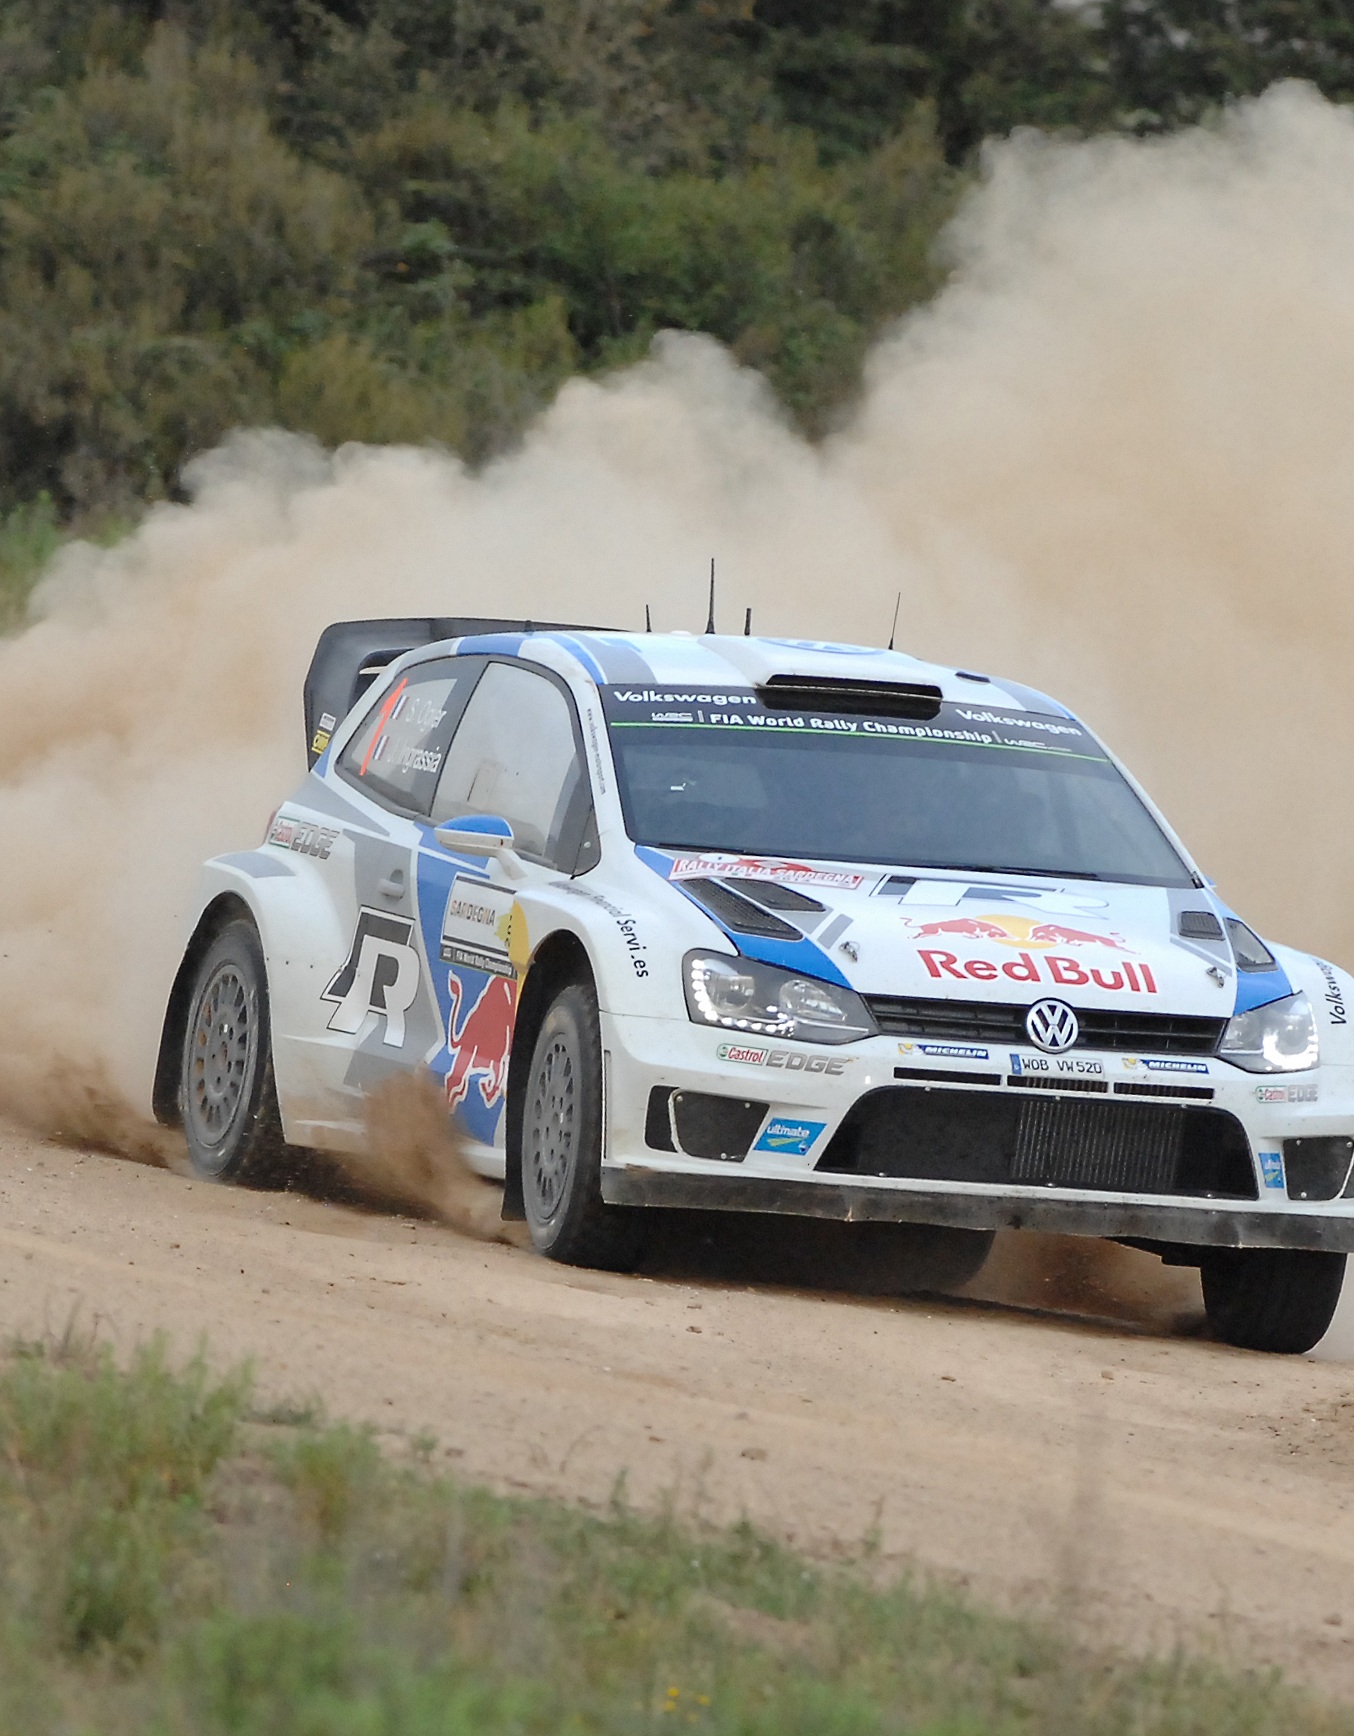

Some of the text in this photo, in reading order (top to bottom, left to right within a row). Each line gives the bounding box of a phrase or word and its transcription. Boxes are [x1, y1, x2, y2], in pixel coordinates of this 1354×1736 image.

[613, 690, 757, 706] Volkswagen
[710, 713, 743, 725] FIA
[747, 714, 804, 727] World
[810, 717, 858, 732] Rally
[862, 721, 992, 745] Championship
[955, 708, 1082, 736] Volkswagen
[677, 858, 724, 873] RALLY
[725, 864, 772, 877] ITALIA
[773, 868, 855, 884] SARDEGNA
[616, 919, 649, 977] Servies
[917, 950, 1157, 993] Red Bull
[728, 1046, 848, 1076] Castrol EDGE
[924, 1046, 987, 1058] MICHELIN
[1022, 1058, 1049, 1071] WOB
[1149, 1061, 1207, 1072] MICHELIN
[766, 1124, 810, 1138] ultimate
